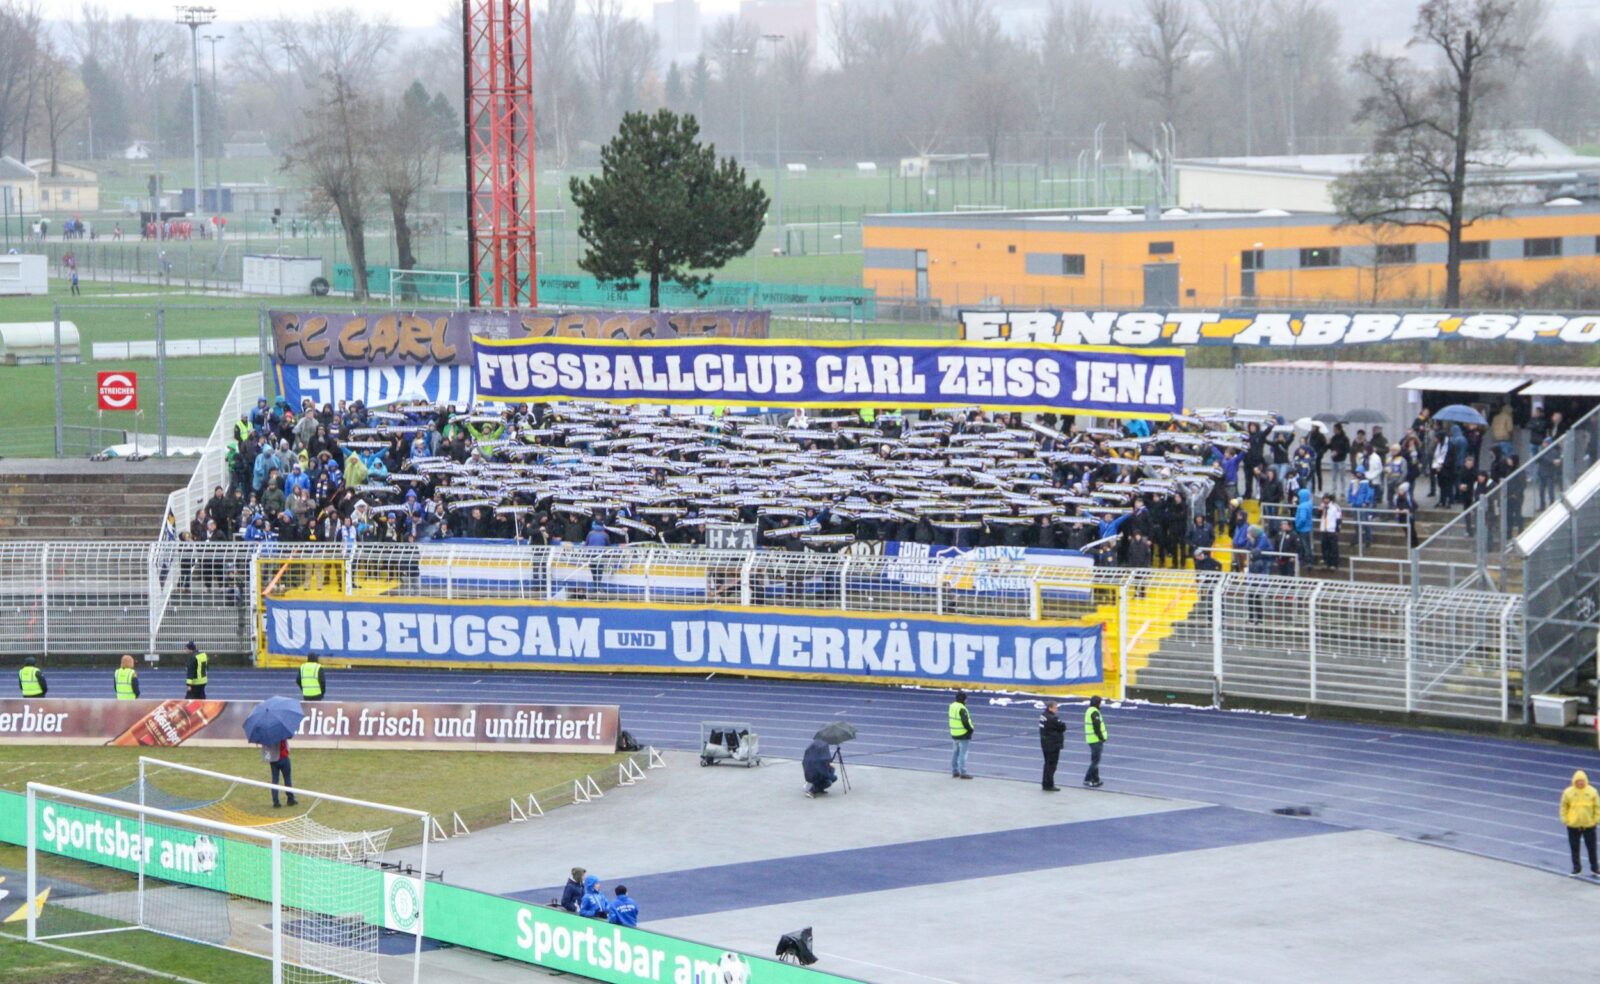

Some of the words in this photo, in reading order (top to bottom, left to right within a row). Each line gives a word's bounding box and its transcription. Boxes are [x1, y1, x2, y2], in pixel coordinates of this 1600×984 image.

[272, 313, 331, 362] FC
[338, 314, 457, 363] CARL
[961, 311, 1221, 345] ERNST
[1233, 313, 1451, 346] ABBE
[100, 387, 135, 395] STREICHER
[477, 351, 803, 394] FUSSBALLCLUB
[815, 355, 926, 395] CARL
[938, 355, 1062, 398] ZEISS
[1072, 360, 1177, 405] JENA
[271, 607, 600, 659] UNBEUGSAM
[616, 631, 656, 648] UND
[671, 620, 1098, 681] UNVERKÄUFLICH
[0, 704, 68, 732] erbier
[294, 707, 350, 736] rlich
[358, 708, 425, 737] frisch
[434, 709, 476, 738] und
[485, 710, 602, 741] unfiltriert!
[42, 806, 154, 864] Sportsbar
[516, 908, 665, 982] Sportsbar
[674, 954, 721, 984] am
